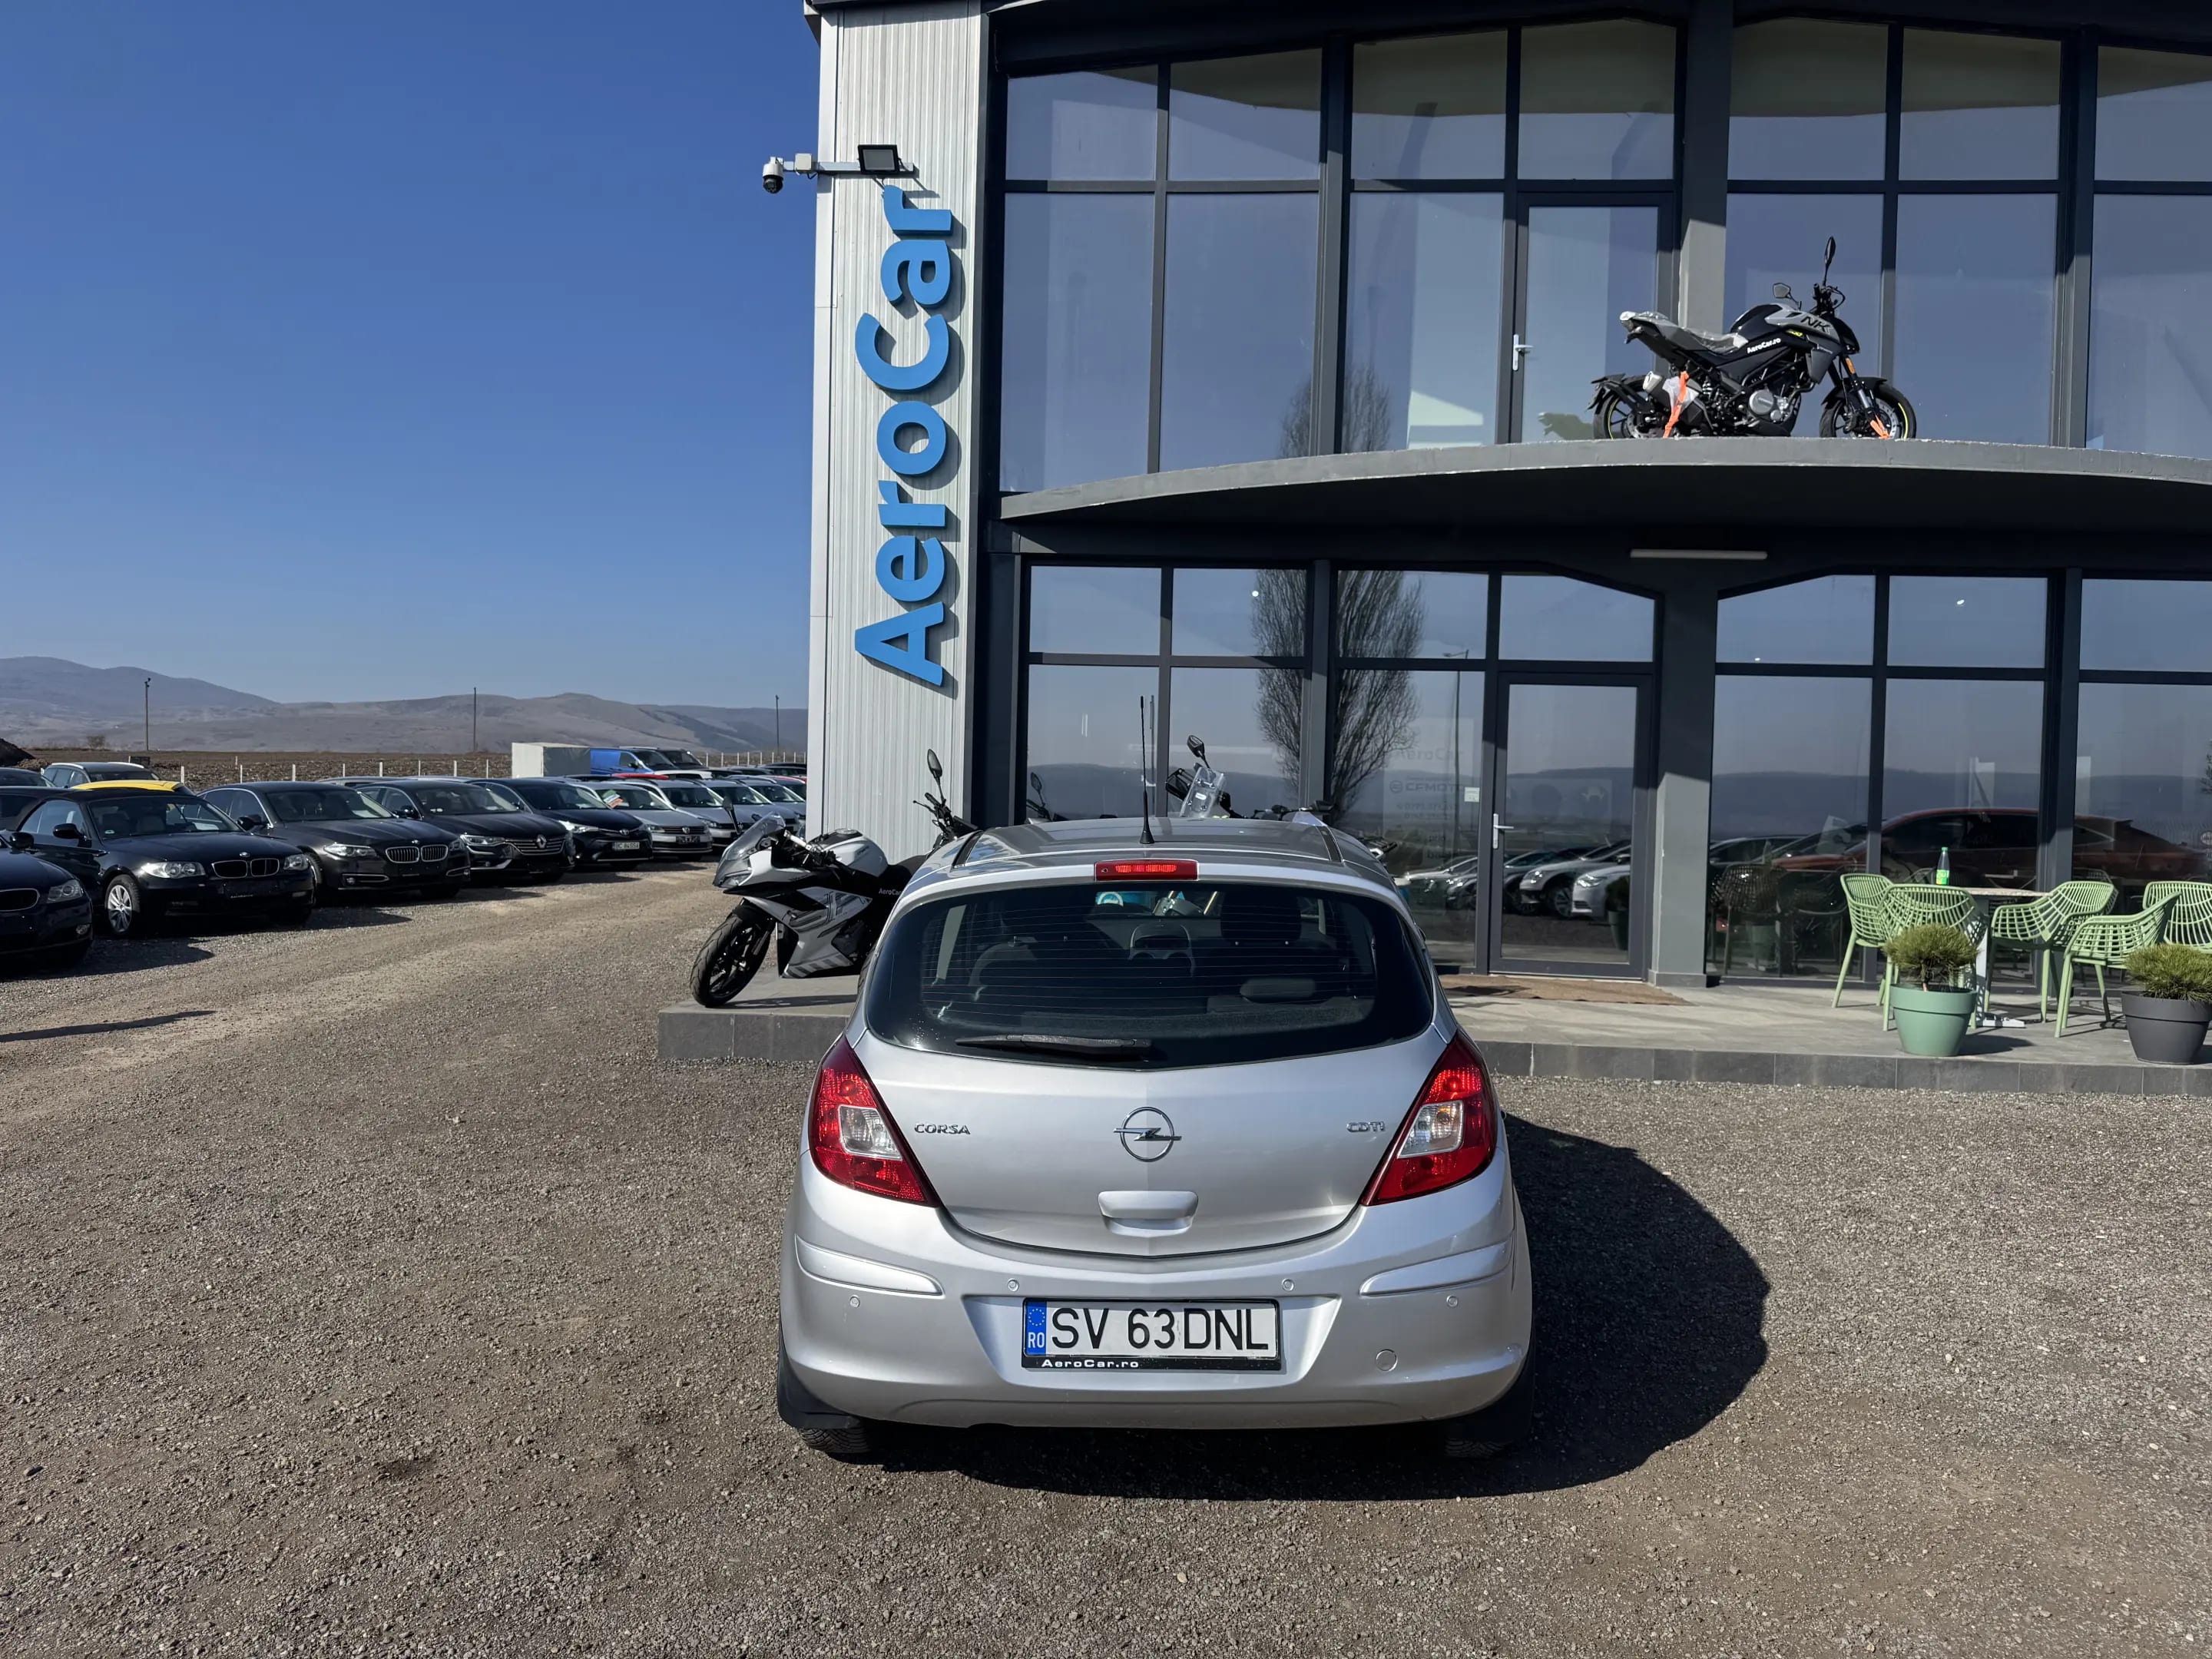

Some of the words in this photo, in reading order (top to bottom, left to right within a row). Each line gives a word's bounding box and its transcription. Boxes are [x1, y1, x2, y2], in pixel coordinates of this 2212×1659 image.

[1747, 338, 1781, 353] AeroCar.ro
[855, 185, 952, 687] AeroCar
[914, 1124, 971, 1134] CORSA
[1051, 1307, 1109, 1349] SV
[1028, 1332, 1045, 1349] RO
[1041, 1359, 1139, 1369] AeroCar.ro
